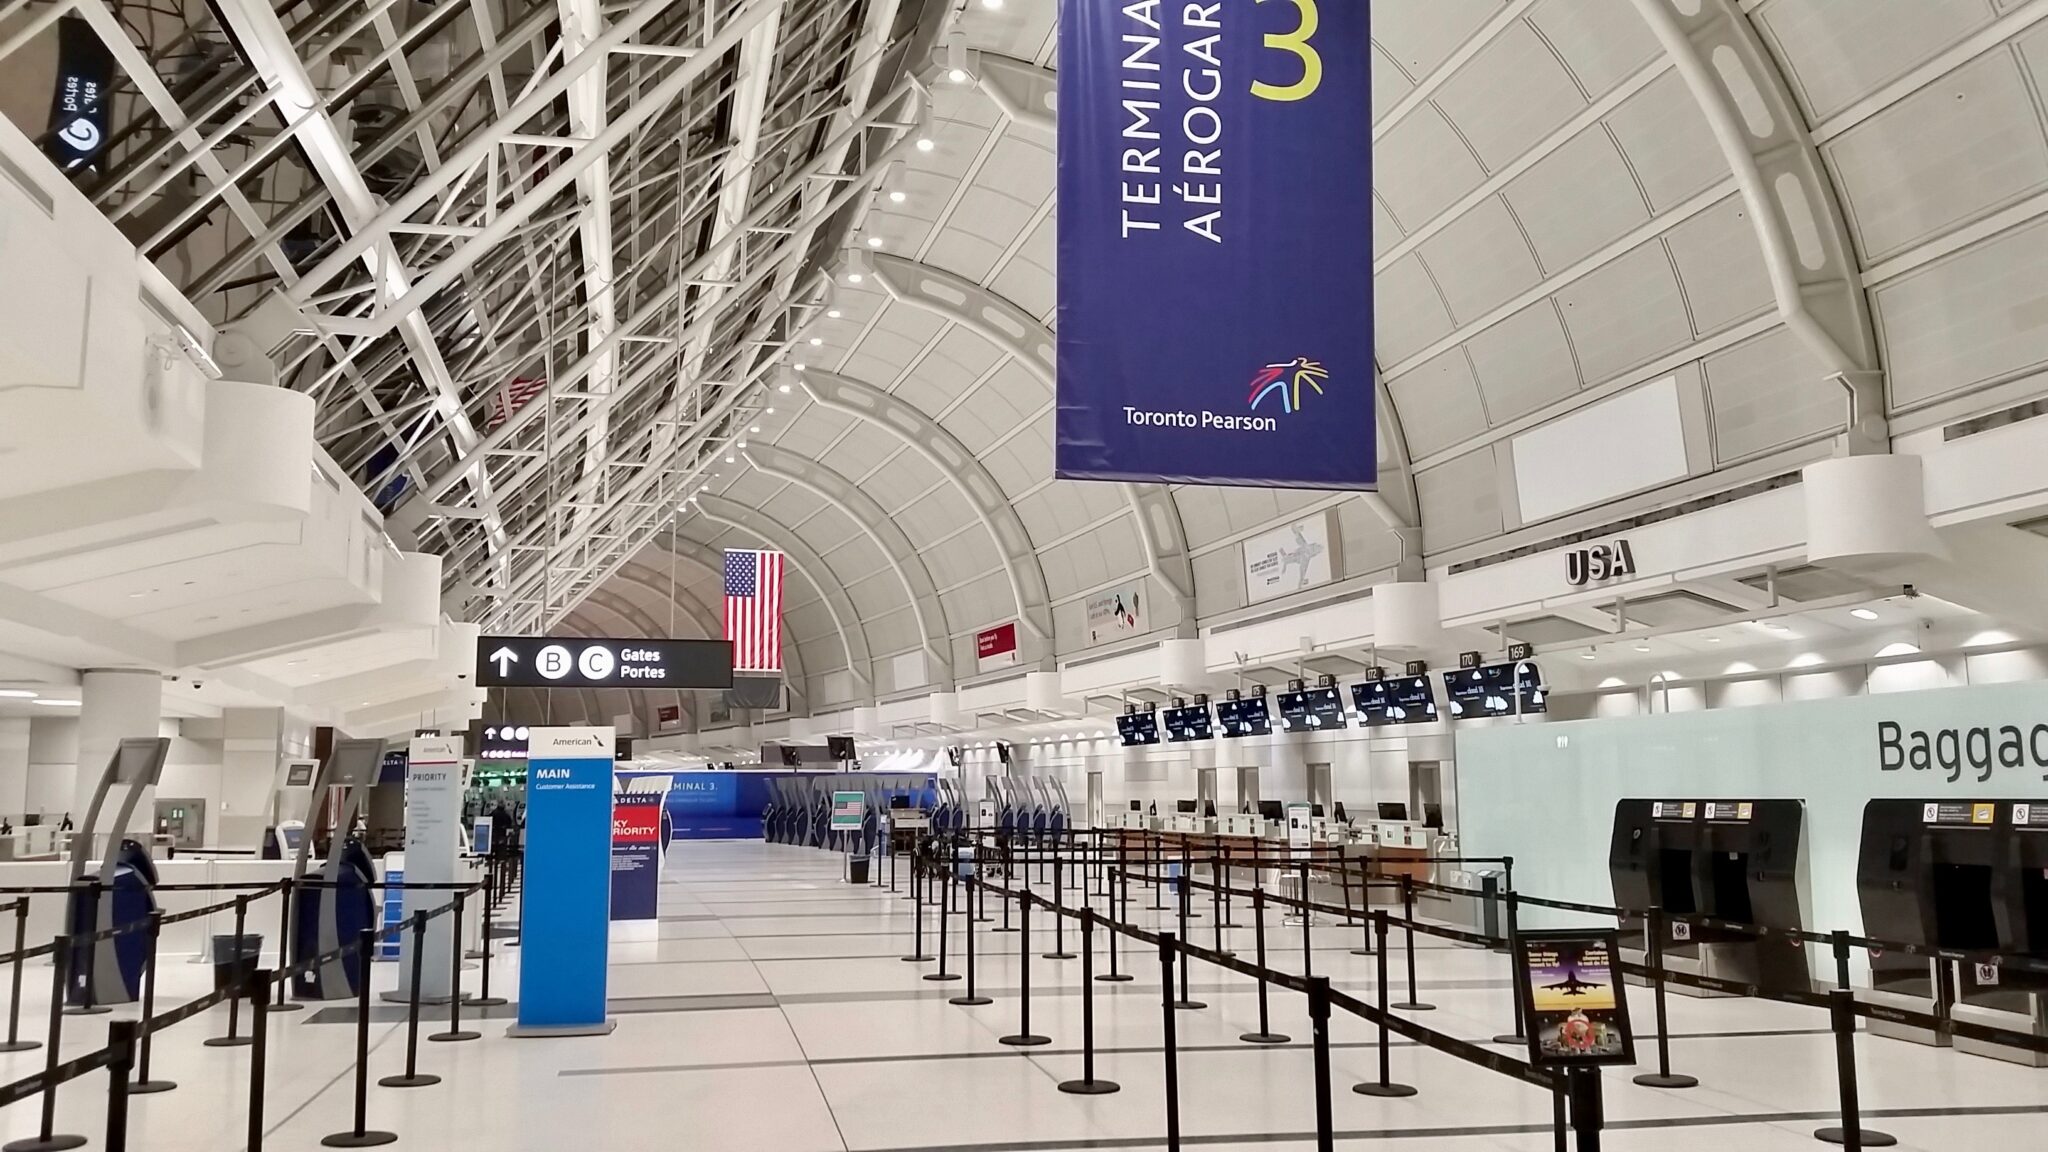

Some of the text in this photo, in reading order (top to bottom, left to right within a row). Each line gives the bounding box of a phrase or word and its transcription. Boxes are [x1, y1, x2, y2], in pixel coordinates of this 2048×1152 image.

[1250, 0, 1323, 101] 3
[1122, 0, 1161, 238] TERMINA
[1172, 2, 1222, 243] AÉROGAR
[1123, 406, 1276, 431] Toronto Pearson
[1565, 539, 1636, 585] USA
[621, 648, 660, 662] Gates
[1510, 646, 1524, 659] 169
[1462, 654, 1473, 666] 170
[621, 665, 665, 678] Portes
[1367, 669, 1377, 680] 172
[1409, 663, 1418, 674] 171
[1321, 676, 1329, 687] 173
[553, 738, 592, 746] American
[1878, 720, 2048, 783] Baggag
[413, 773, 447, 781] PRIORITY
[536, 768, 570, 779] MAIN
[673, 782, 705, 791] MINAL
[613, 820, 628, 828] KY
[613, 827, 656, 835] RIORITY
